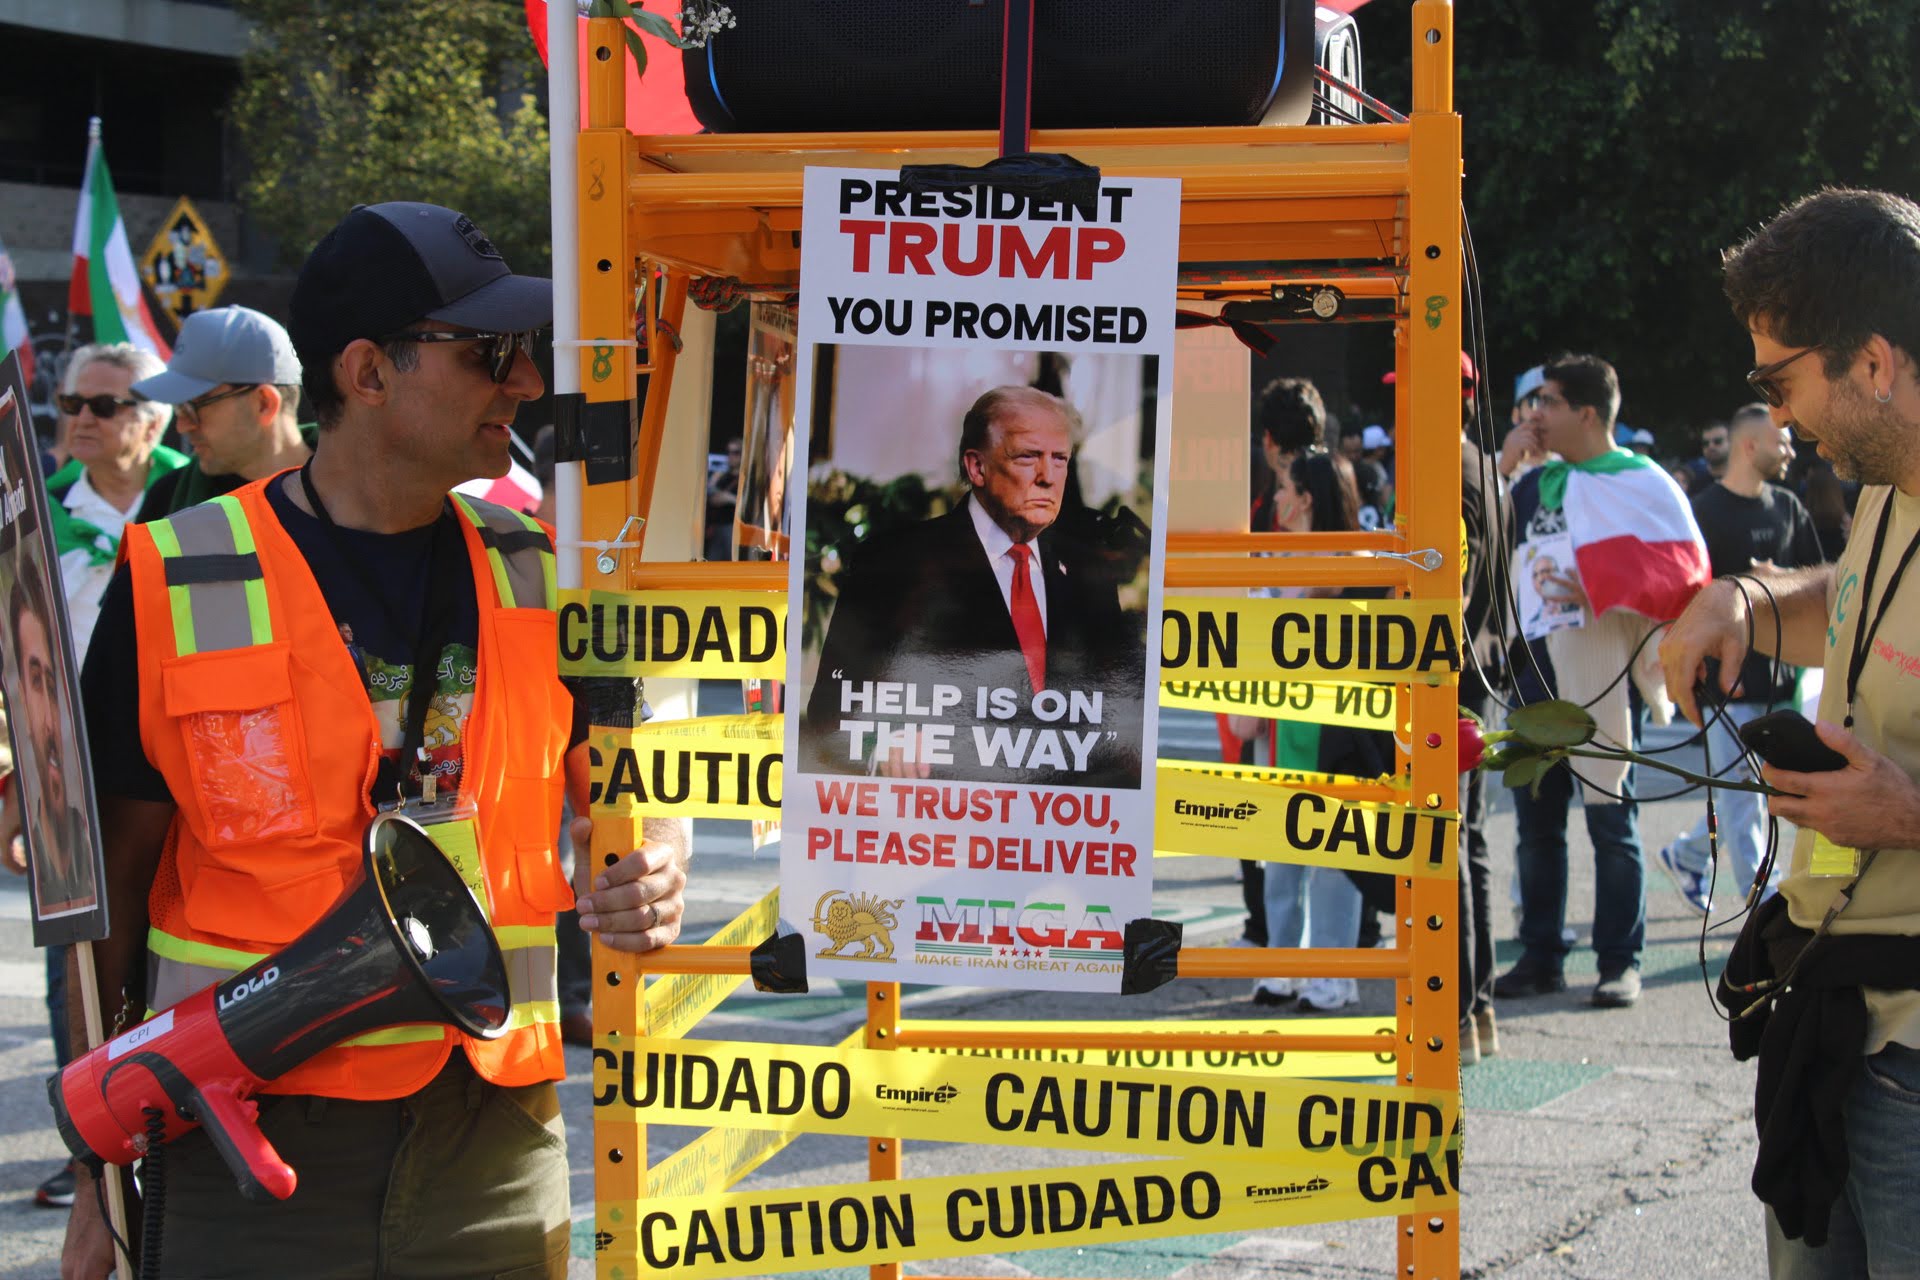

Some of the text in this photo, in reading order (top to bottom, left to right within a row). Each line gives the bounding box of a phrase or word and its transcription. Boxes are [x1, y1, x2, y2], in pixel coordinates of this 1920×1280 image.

[839, 219, 1127, 281] TRUMP
[827, 296, 913, 337] YOU
[925, 300, 1148, 344] PROMISED
[592, 337, 615, 383] 8
[559, 602, 788, 663] CUIDAD
[976, 686, 1018, 721] IS
[1031, 690, 1103, 724] ON
[839, 720, 955, 766] THE
[815, 780, 1121, 835] WE TRUST YOU,
[1174, 799, 1248, 821] Empire
[807, 827, 1137, 877] PLEASE DELIVER
[915, 895, 1124, 950] MIGA
[915, 953, 962, 968] MAKE
[968, 957, 1009, 969] IRAN
[1014, 960, 1069, 973] GREAT
[128, 1026, 151, 1044] CPI
[593, 1047, 1459, 1163] CUIDADO Empire CAUTION CUID
[640, 1193, 916, 1270] CAUTION
[946, 1171, 1221, 1243] CUIDADO
